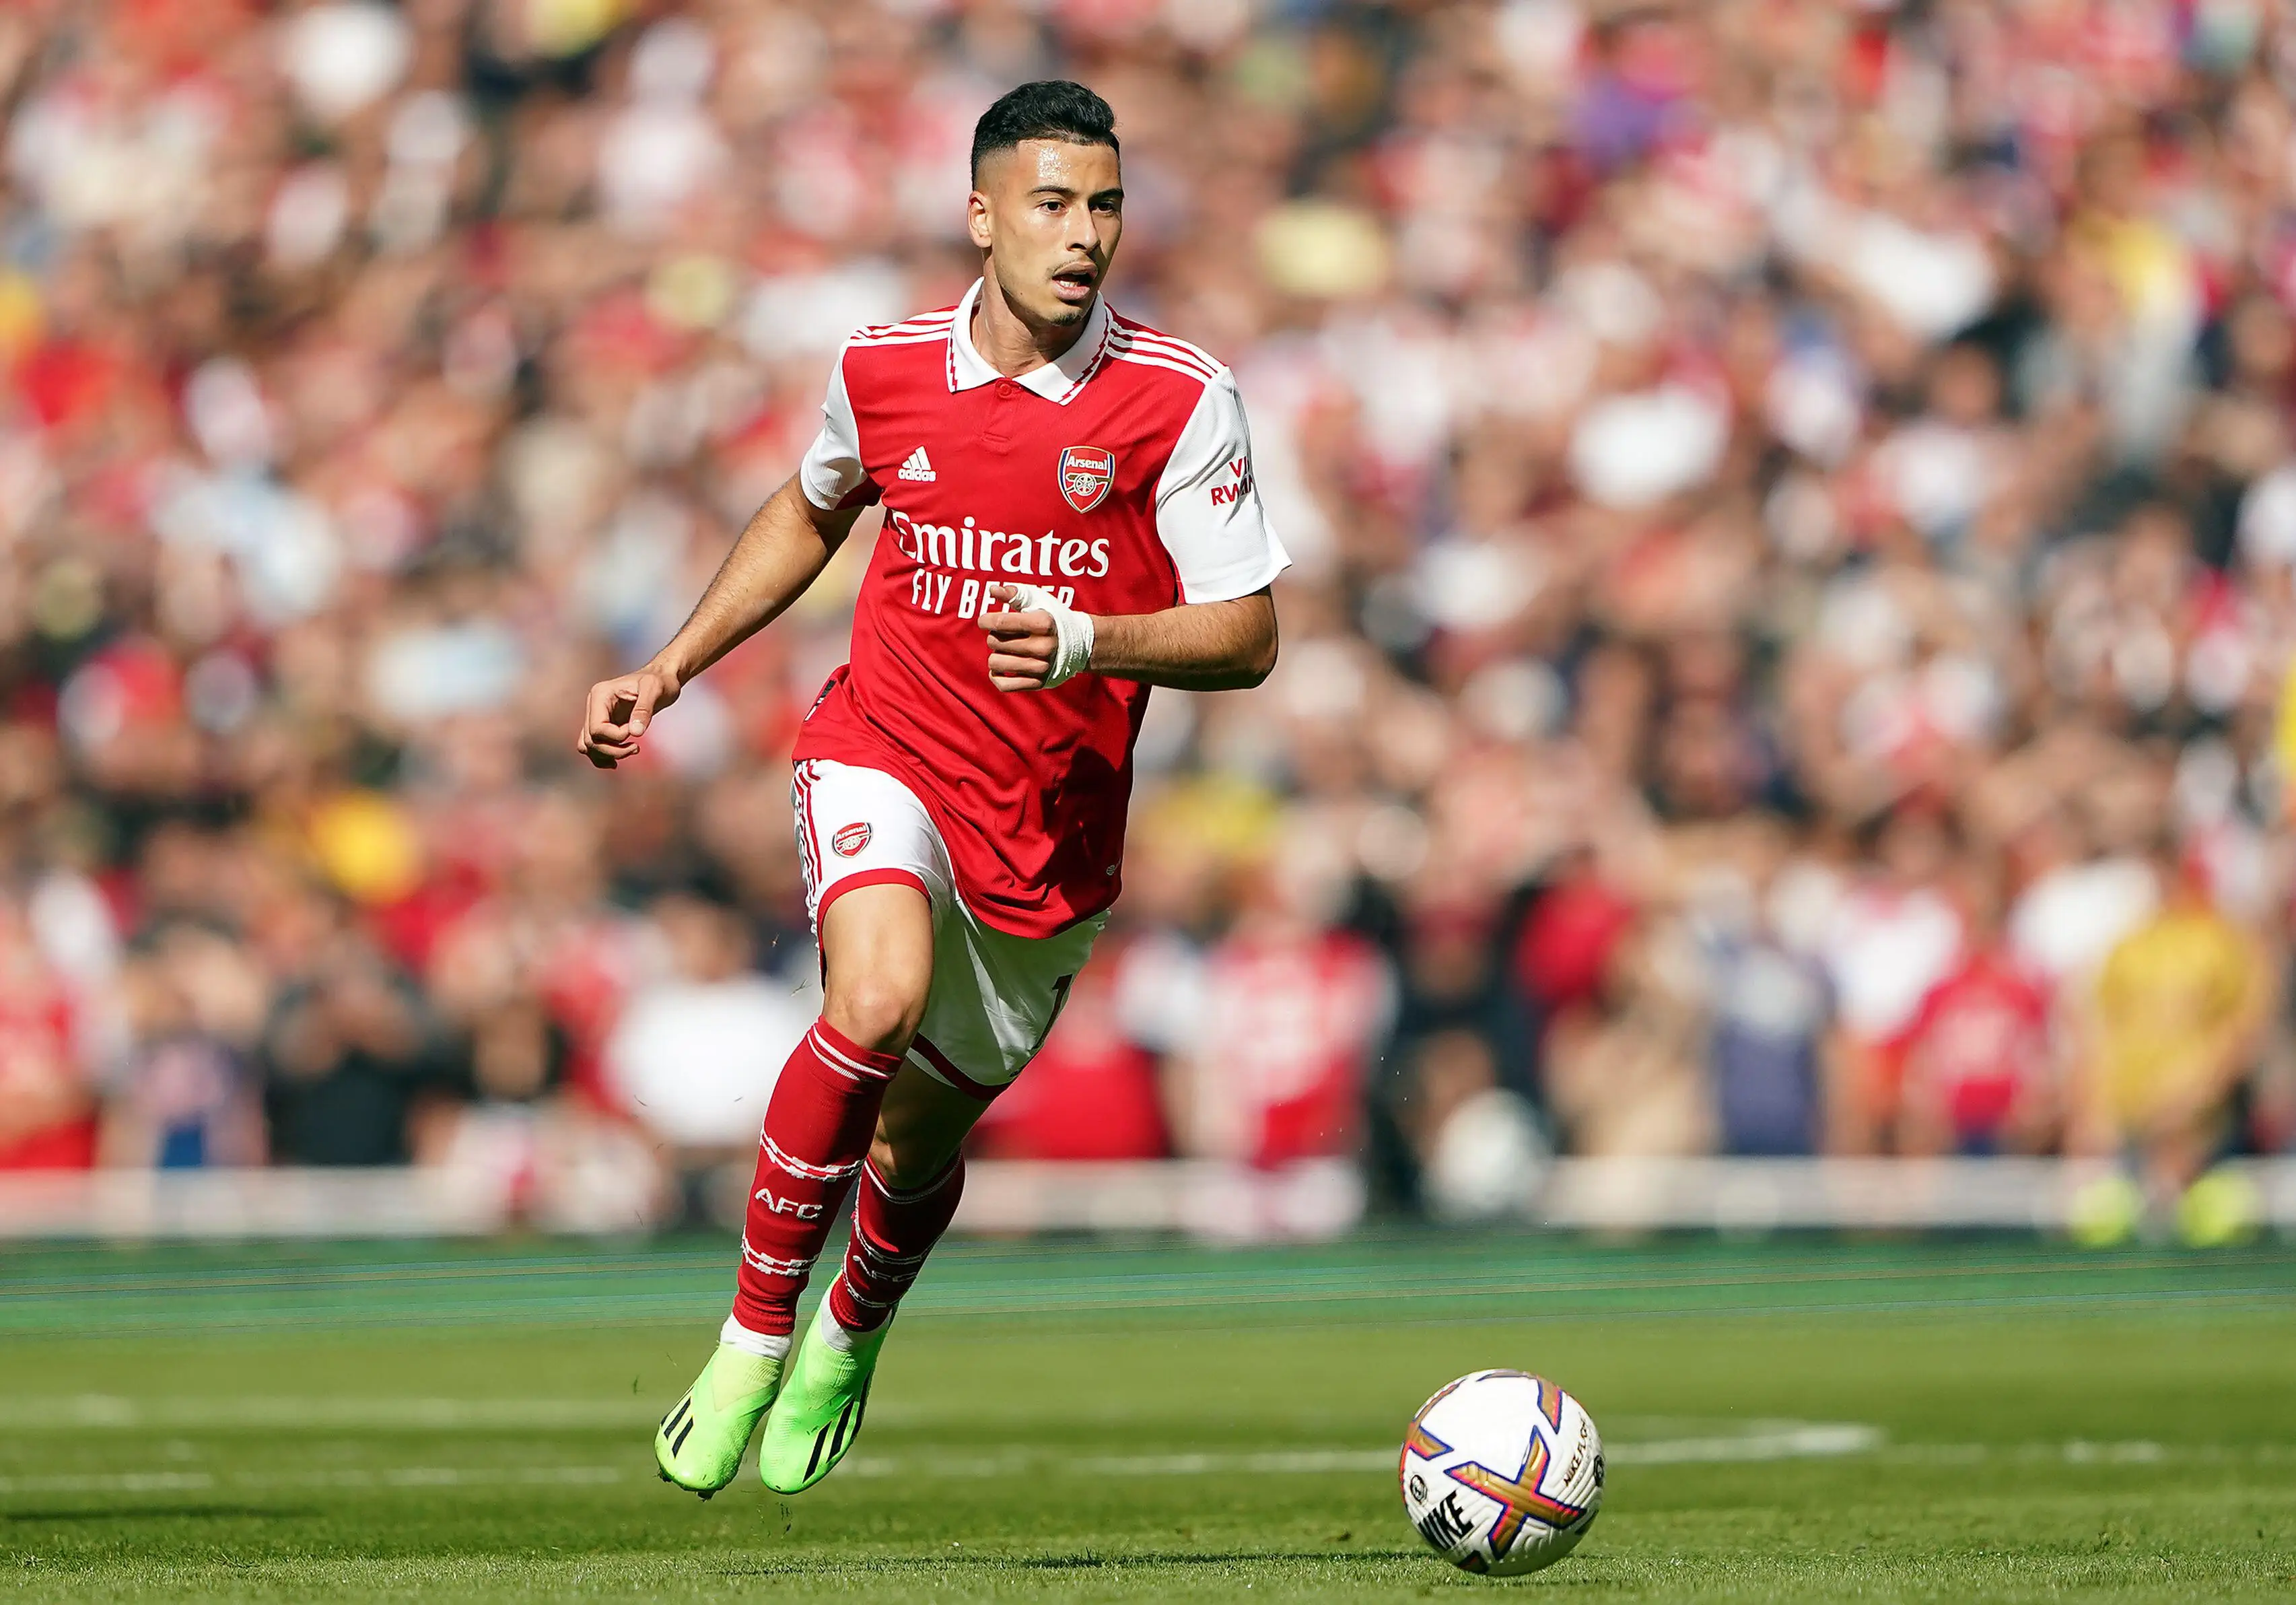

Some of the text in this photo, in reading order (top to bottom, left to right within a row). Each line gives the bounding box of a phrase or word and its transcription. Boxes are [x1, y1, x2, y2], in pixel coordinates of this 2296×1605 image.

[898, 466, 936, 482] adidas
[1067, 455, 1107, 471] Arsenal
[892, 509, 1110, 578] Emirates
[911, 568, 952, 615] FLY
[755, 1188, 823, 1219] AFC
[1418, 1490, 1475, 1552] NIKE
